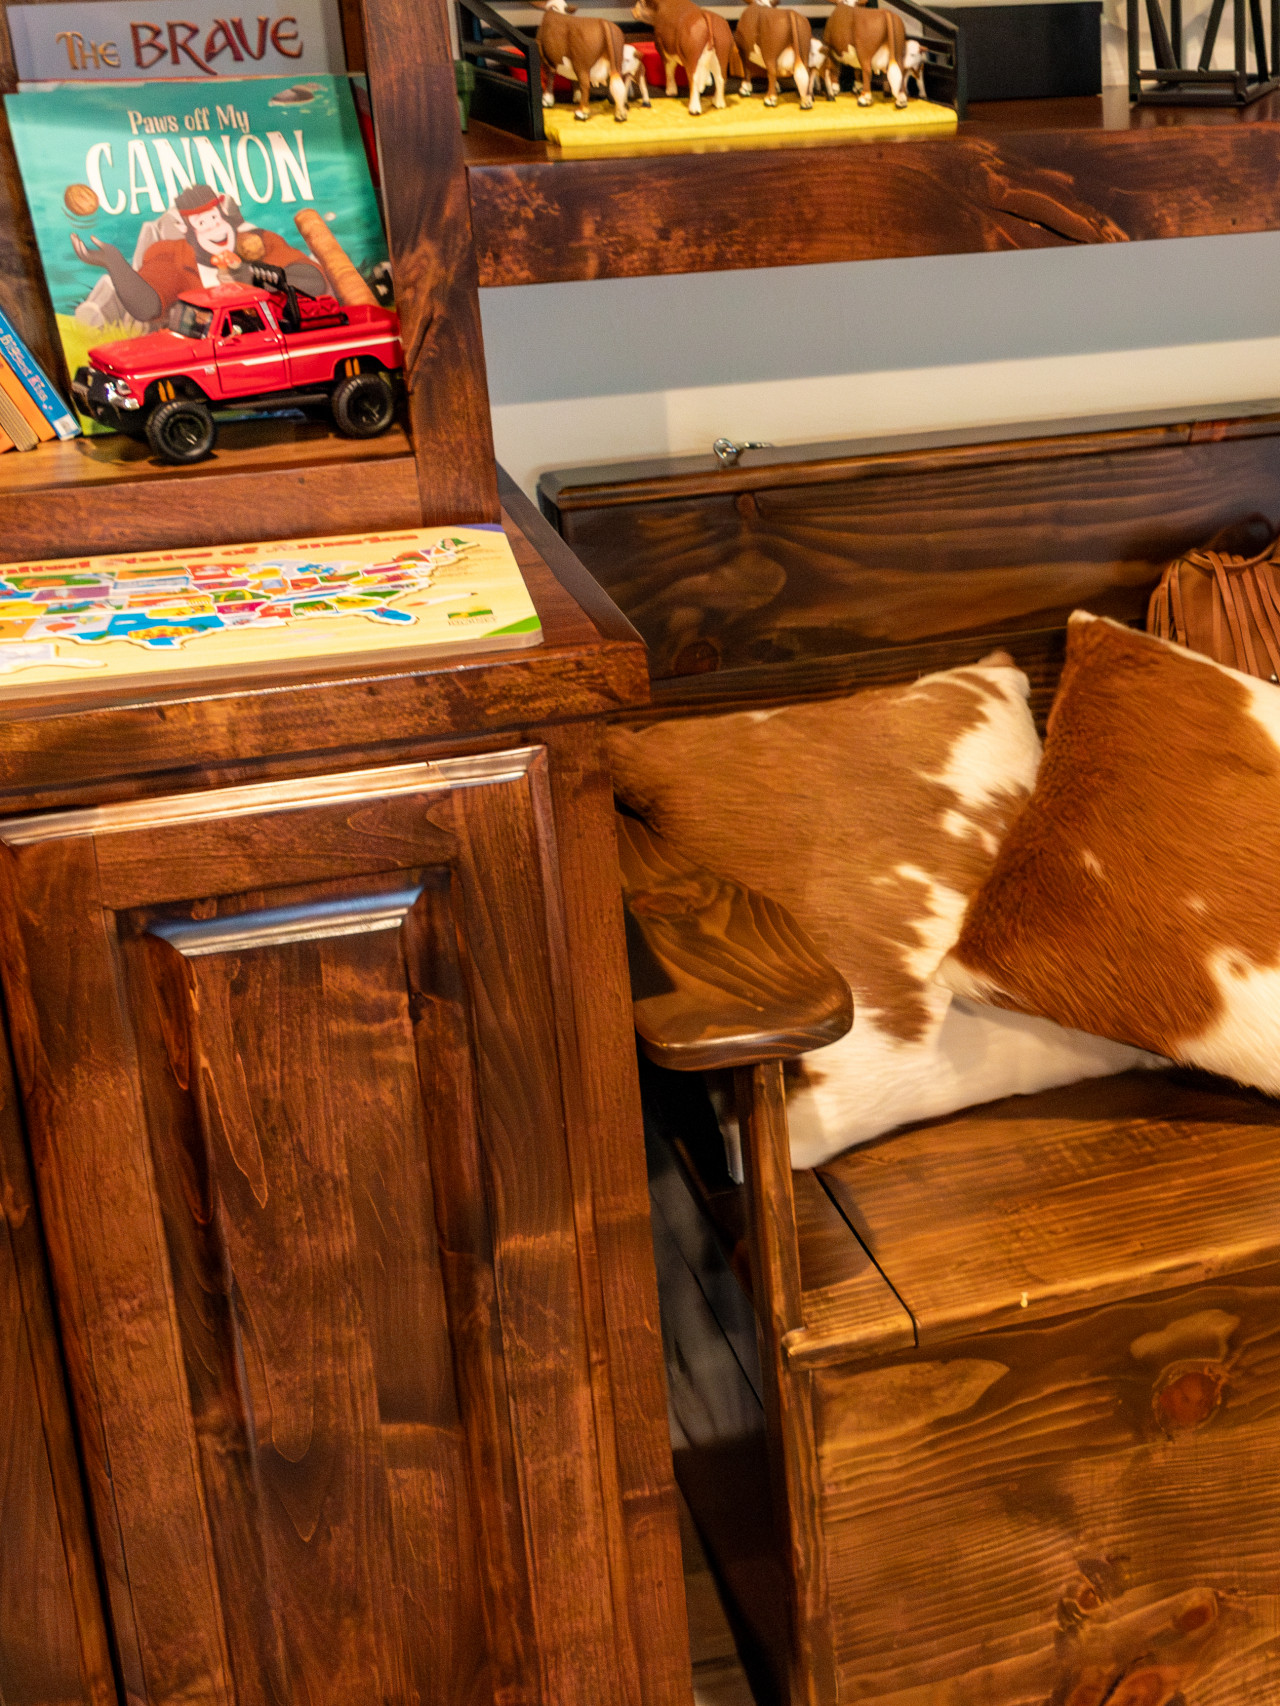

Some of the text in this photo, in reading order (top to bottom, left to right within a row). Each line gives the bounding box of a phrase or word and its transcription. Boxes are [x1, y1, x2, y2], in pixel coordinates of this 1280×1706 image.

[130, 16, 304, 75] BRAVE
[127, 104, 250, 136] Paws off My
[86, 129, 314, 215] CANNON
